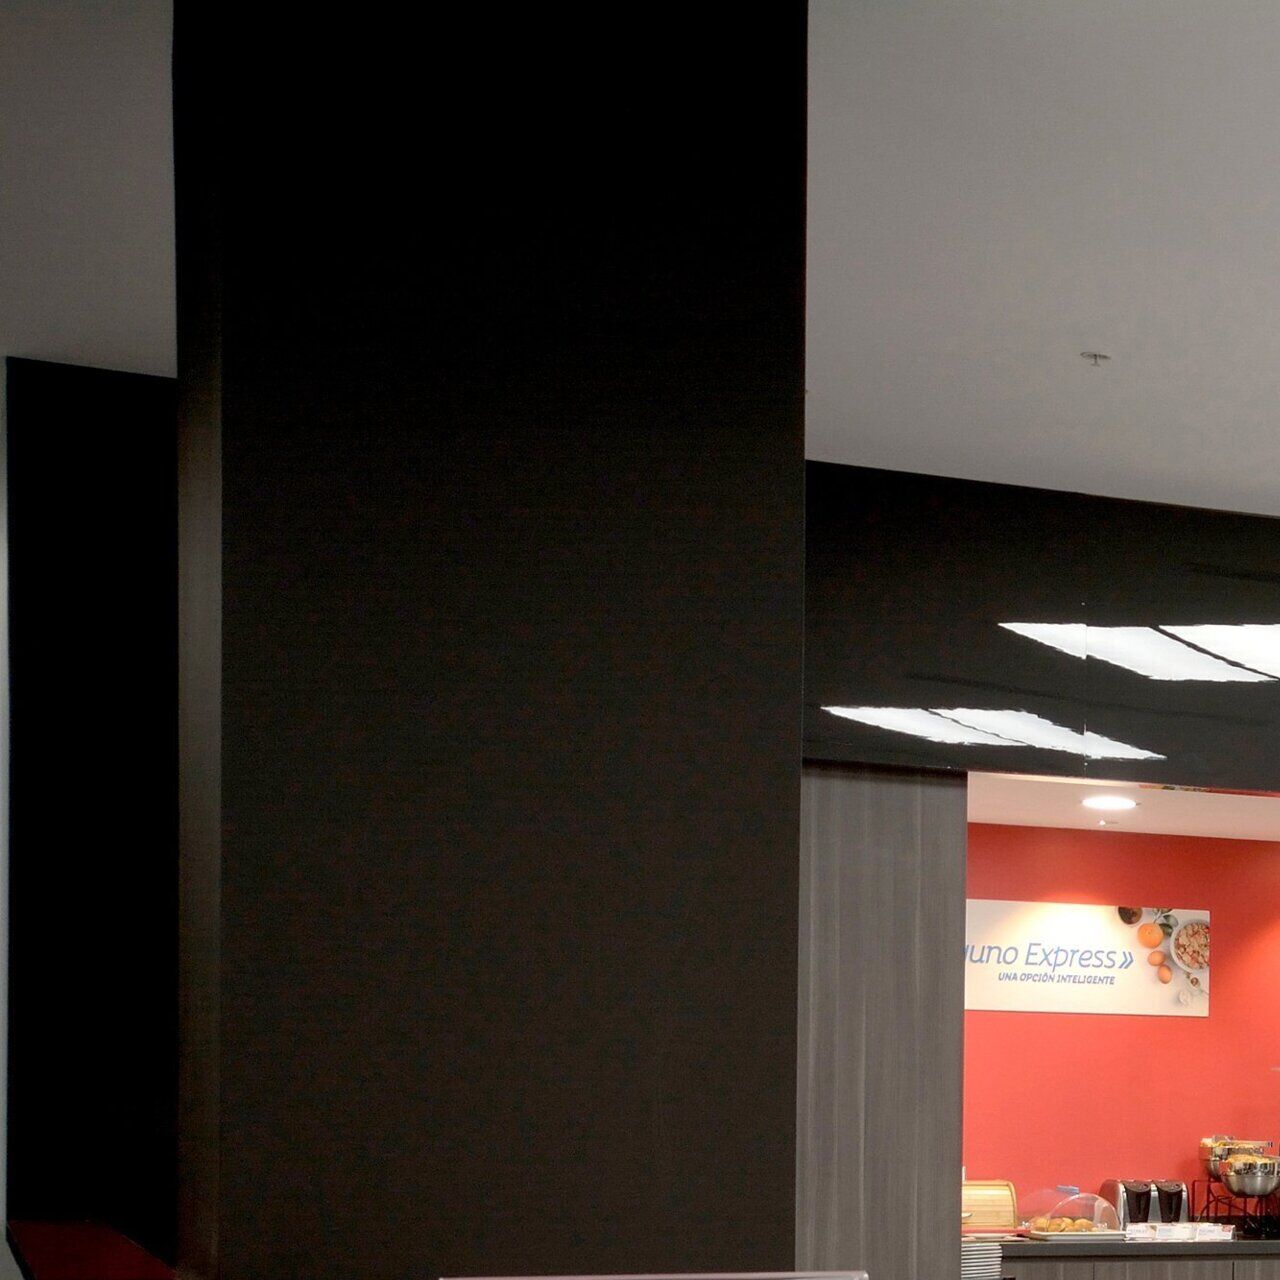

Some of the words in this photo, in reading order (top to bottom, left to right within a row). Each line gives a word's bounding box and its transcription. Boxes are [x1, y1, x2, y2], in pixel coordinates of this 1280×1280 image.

[998, 972, 1018, 982] UNA
[1020, 972, 1055, 983] OPCIÓN
[1056, 974, 1116, 985] INTELIGENTE
